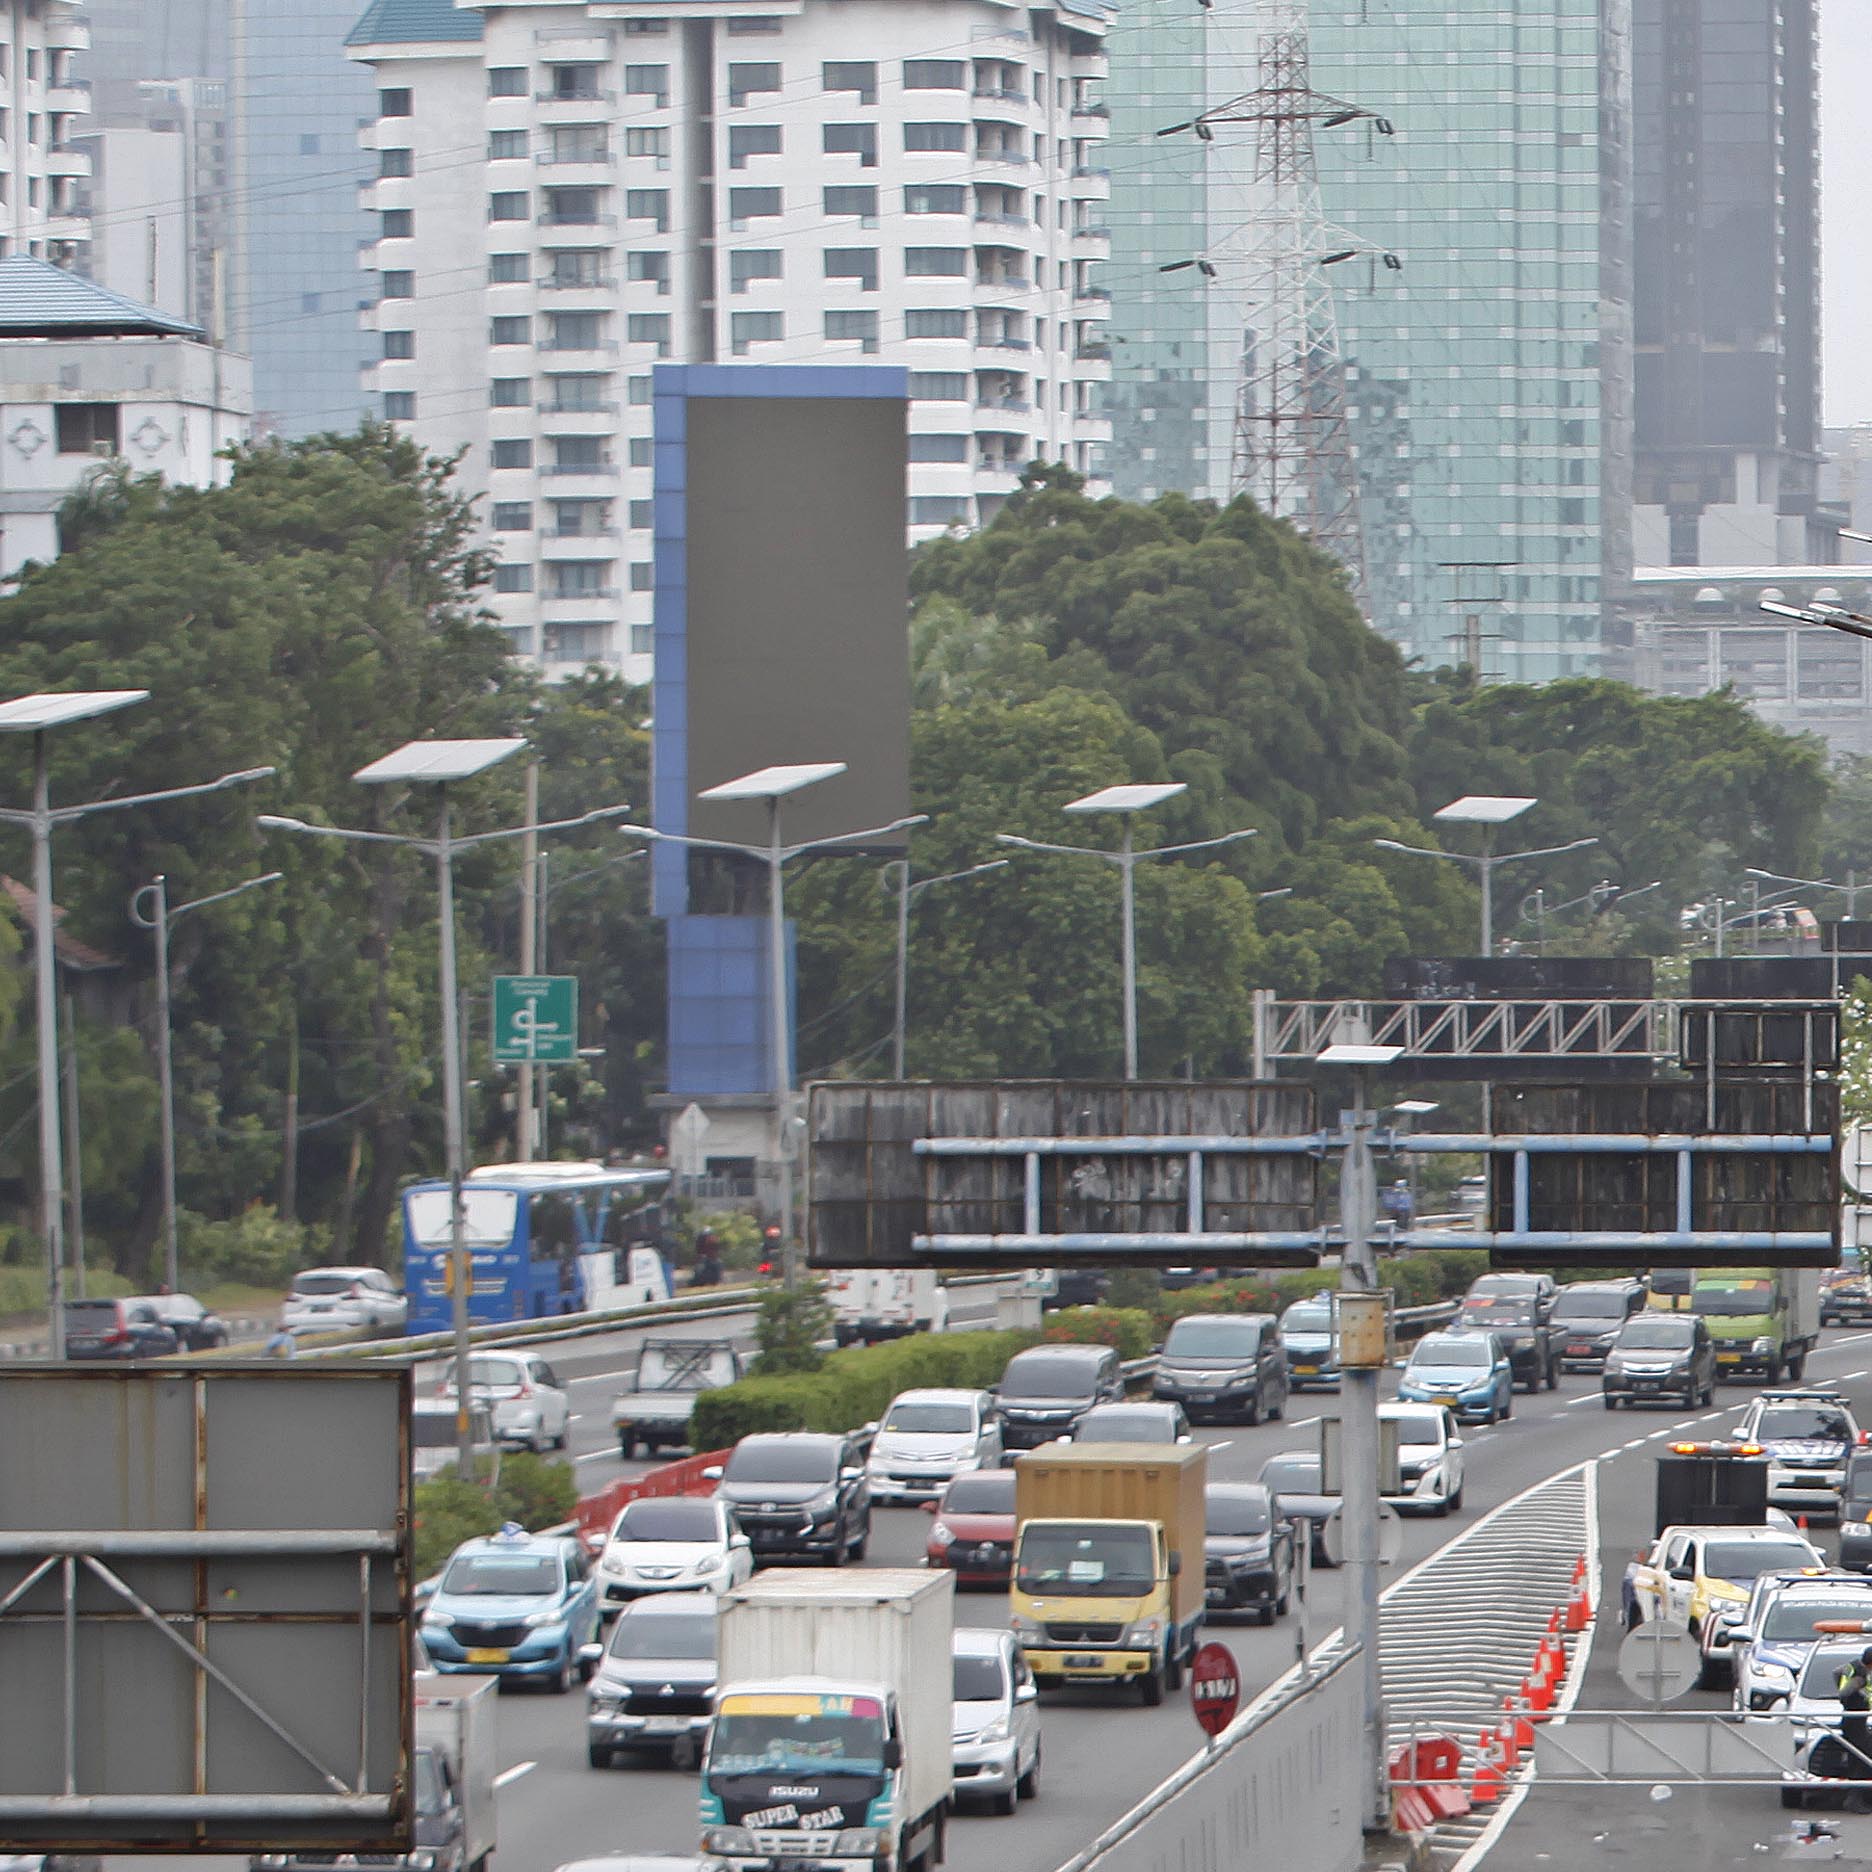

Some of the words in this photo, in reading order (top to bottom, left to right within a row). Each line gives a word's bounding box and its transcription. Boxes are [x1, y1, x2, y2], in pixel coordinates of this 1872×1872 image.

[769, 1786, 819, 1798] ISUZU
[742, 1804, 799, 1830] SUPER
[800, 1806, 844, 1831] STAR
